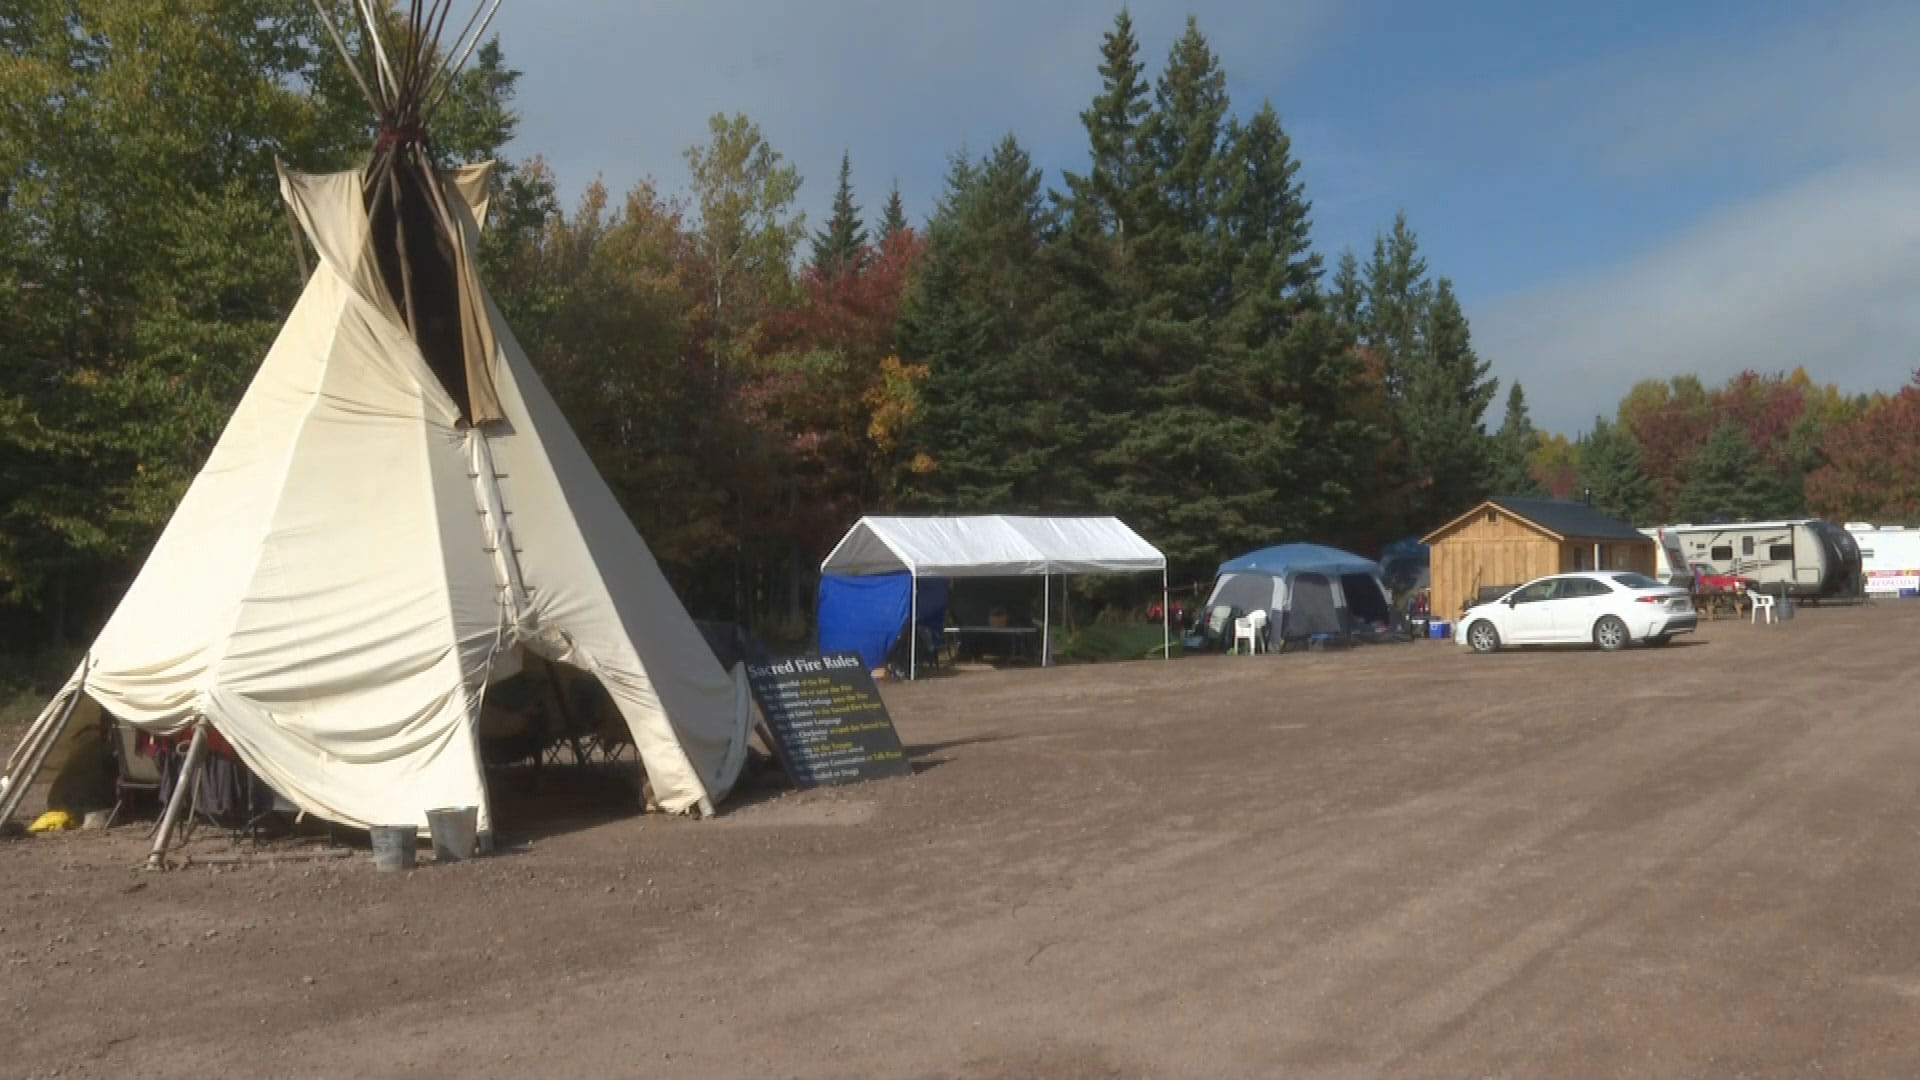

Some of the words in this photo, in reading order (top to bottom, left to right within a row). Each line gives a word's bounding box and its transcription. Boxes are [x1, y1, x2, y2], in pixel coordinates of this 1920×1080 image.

[747, 659, 795, 678] Sacred
[795, 658, 822, 673] Fire
[822, 655, 860, 670] Rules
